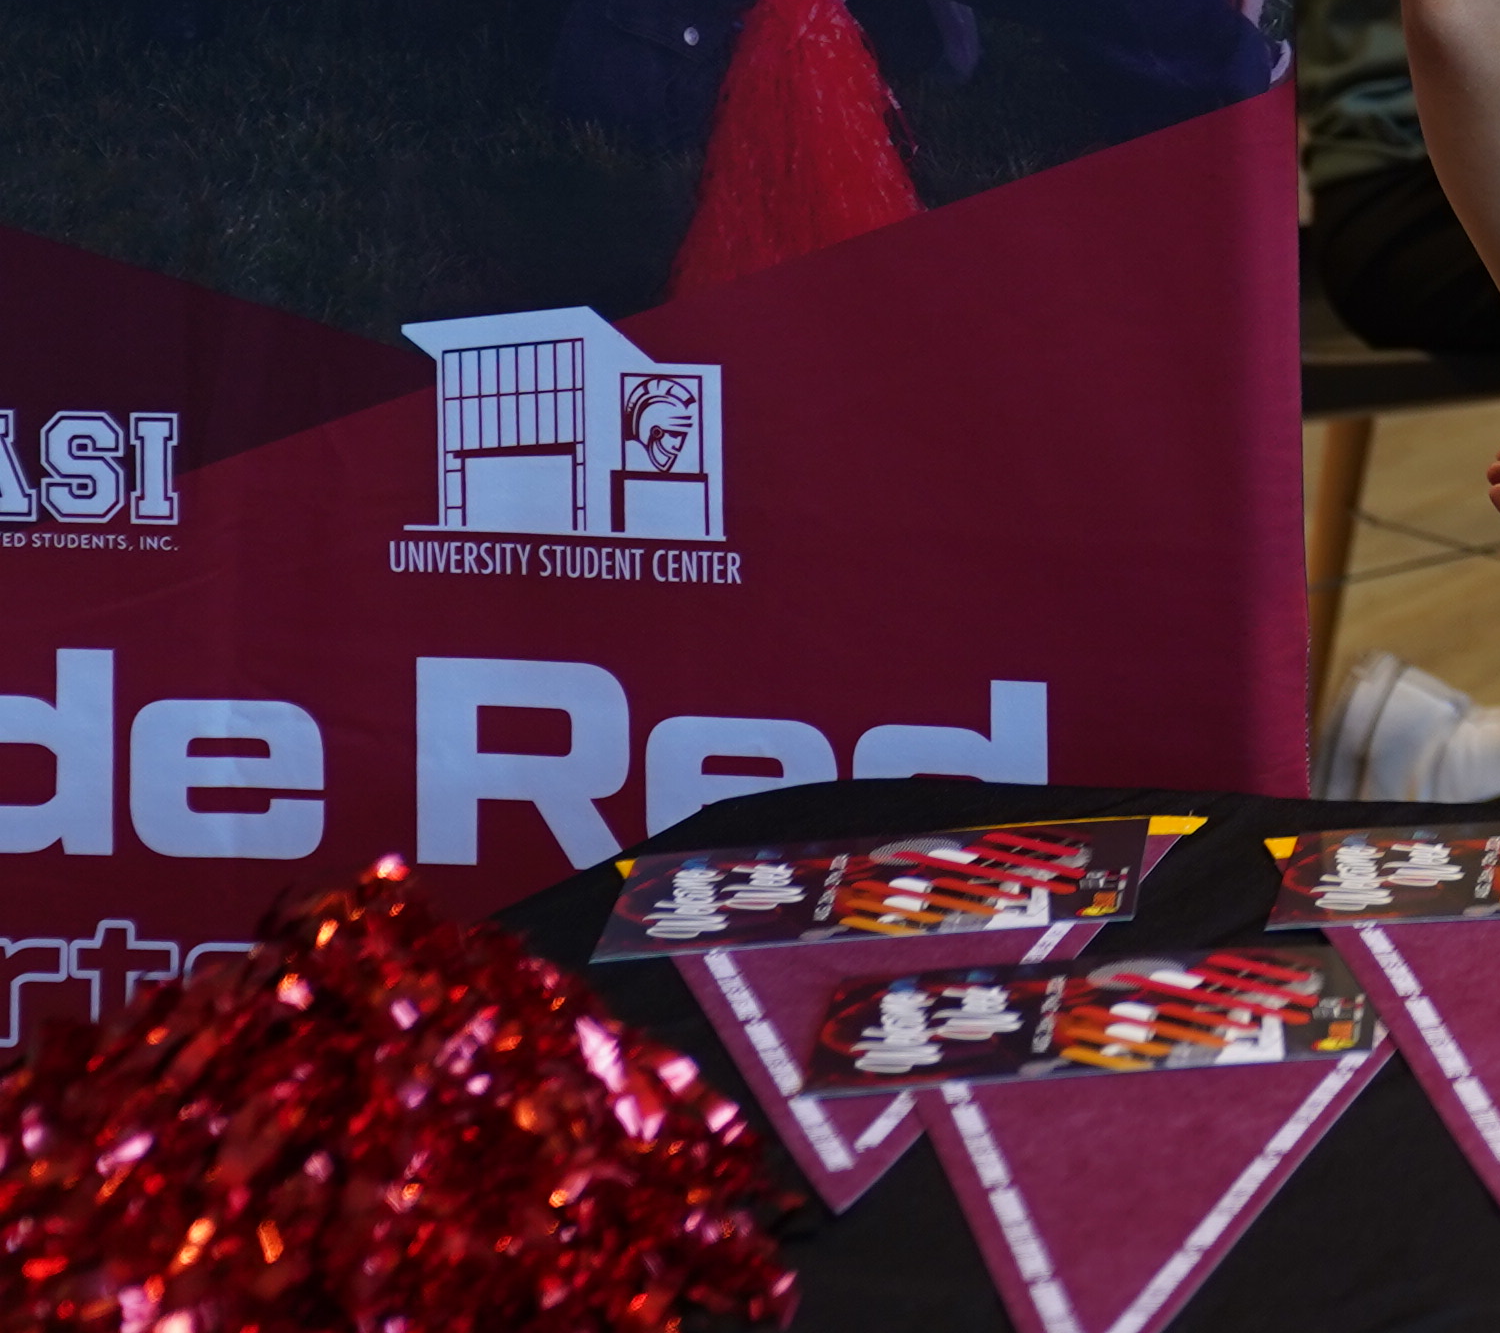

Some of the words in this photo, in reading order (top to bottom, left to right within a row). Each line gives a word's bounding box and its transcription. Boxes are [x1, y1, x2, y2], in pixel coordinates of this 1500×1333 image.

[31, 533, 134, 552] STUDENTS,
[139, 535, 179, 552] INC.
[389, 540, 532, 576] UNIVERSITY
[538, 544, 645, 581] STUDENT
[651, 548, 742, 584] CENTER
